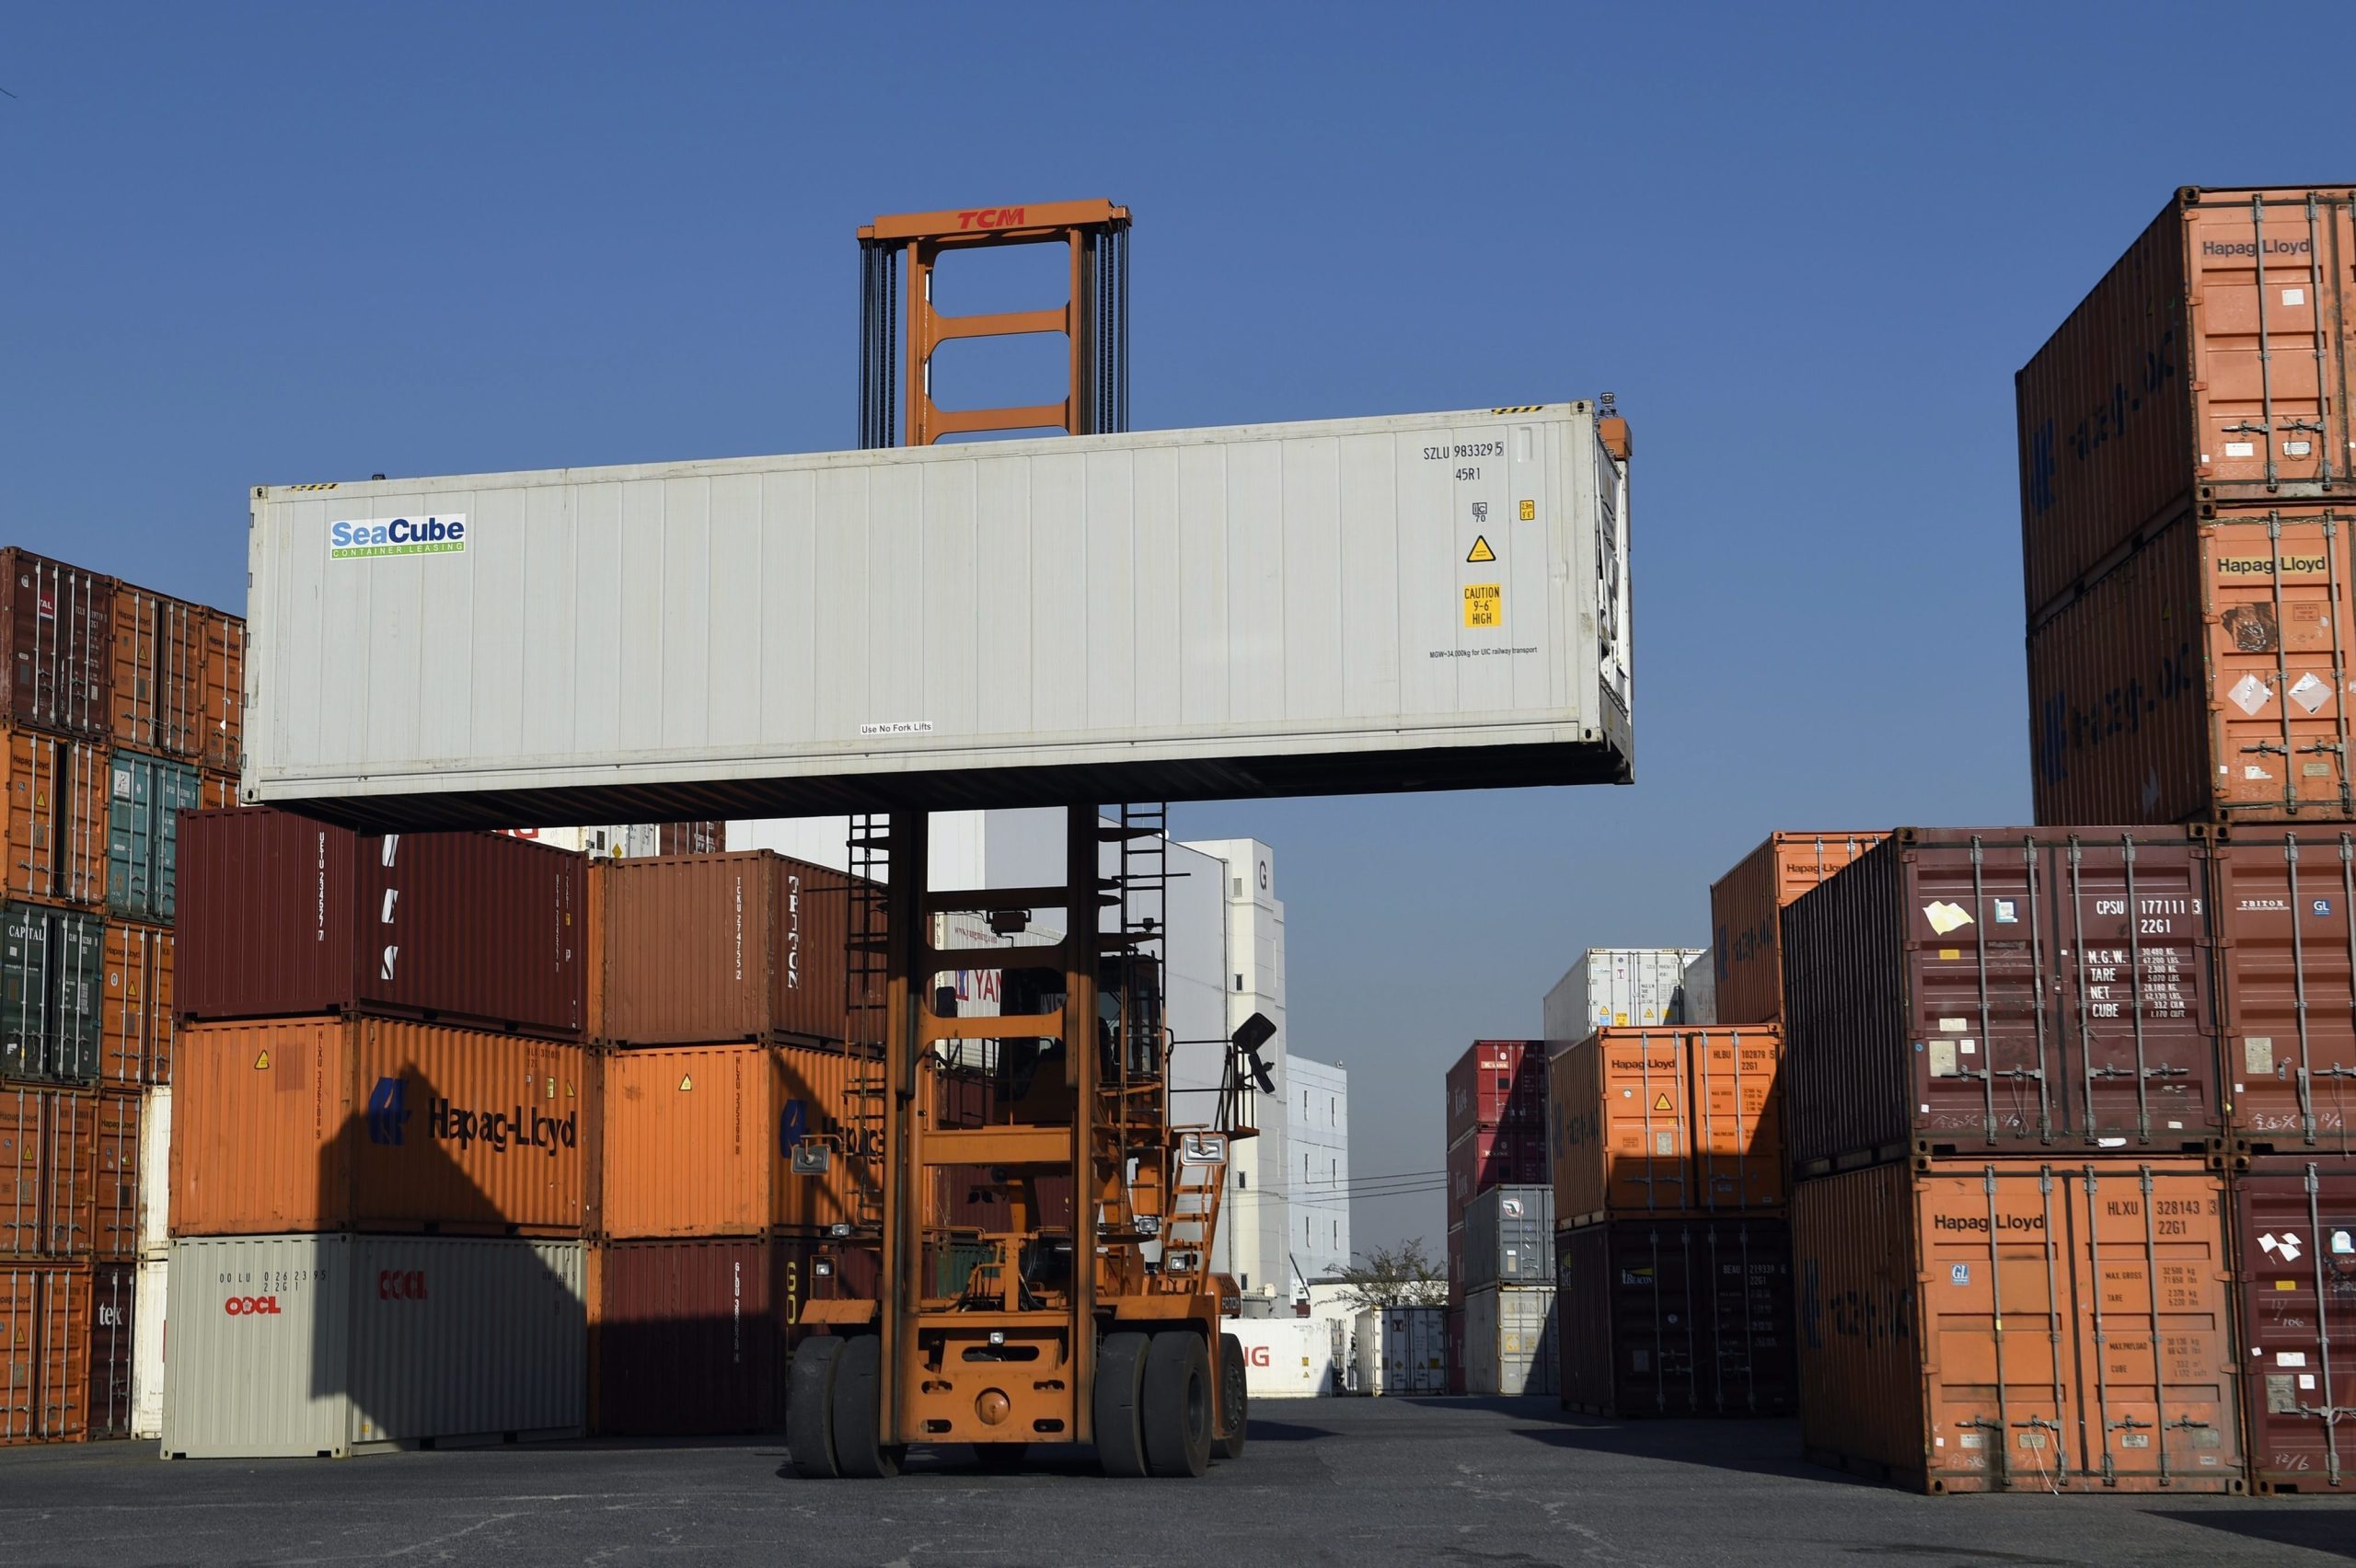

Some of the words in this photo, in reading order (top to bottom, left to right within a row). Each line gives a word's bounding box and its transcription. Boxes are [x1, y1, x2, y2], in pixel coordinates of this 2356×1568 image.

[957, 208, 1024, 229] TCM
[2203, 238, 2310, 257] HapagLloyd
[1424, 446, 1449, 460] SZLU
[1454, 444, 1493, 457] 983329
[1496, 442, 1504, 456] 5
[1456, 467, 1480, 481] 45R1
[331, 517, 464, 547] SeaCube
[333, 546, 402, 557] CONTAINER
[410, 543, 463, 552] LEASING
[2218, 556, 2326, 575] HapagLloyd
[1464, 587, 1500, 600] CAUTION
[1472, 612, 1492, 625] HIGH
[1492, 647, 1511, 656] railway
[1512, 646, 1537, 655] transport
[1259, 860, 1267, 891] G
[2096, 900, 2124, 915] CPSU
[2141, 900, 2185, 914] 177111
[2193, 899, 2202, 915] 3
[2313, 901, 2330, 911] GL
[9, 925, 44, 941] CAPTAL
[2141, 919, 2171, 934] 22G1
[2088, 950, 2126, 964] M.G.W.
[736, 970, 742, 980] 2
[2090, 968, 2116, 982] TARE
[2090, 986, 2110, 999] NET
[2092, 1003, 2119, 1017] CUBE
[1714, 1050, 1731, 1059] HLBU
[1770, 1049, 1775, 1059] 5
[1611, 1059, 1675, 1070] HapagLloyd
[1742, 1061, 1758, 1070] 22G1
[2108, 1201, 2138, 1215] HLXU
[2157, 1200, 2200, 1215] 328143
[2209, 1200, 2217, 1215] 3
[1934, 1214, 2044, 1232] HapagLloyd
[2159, 1221, 2186, 1234] 22G1
[1952, 1265, 1968, 1279] GL
[2107, 1294, 2123, 1302] TARE
[99, 1301, 122, 1325] tex
